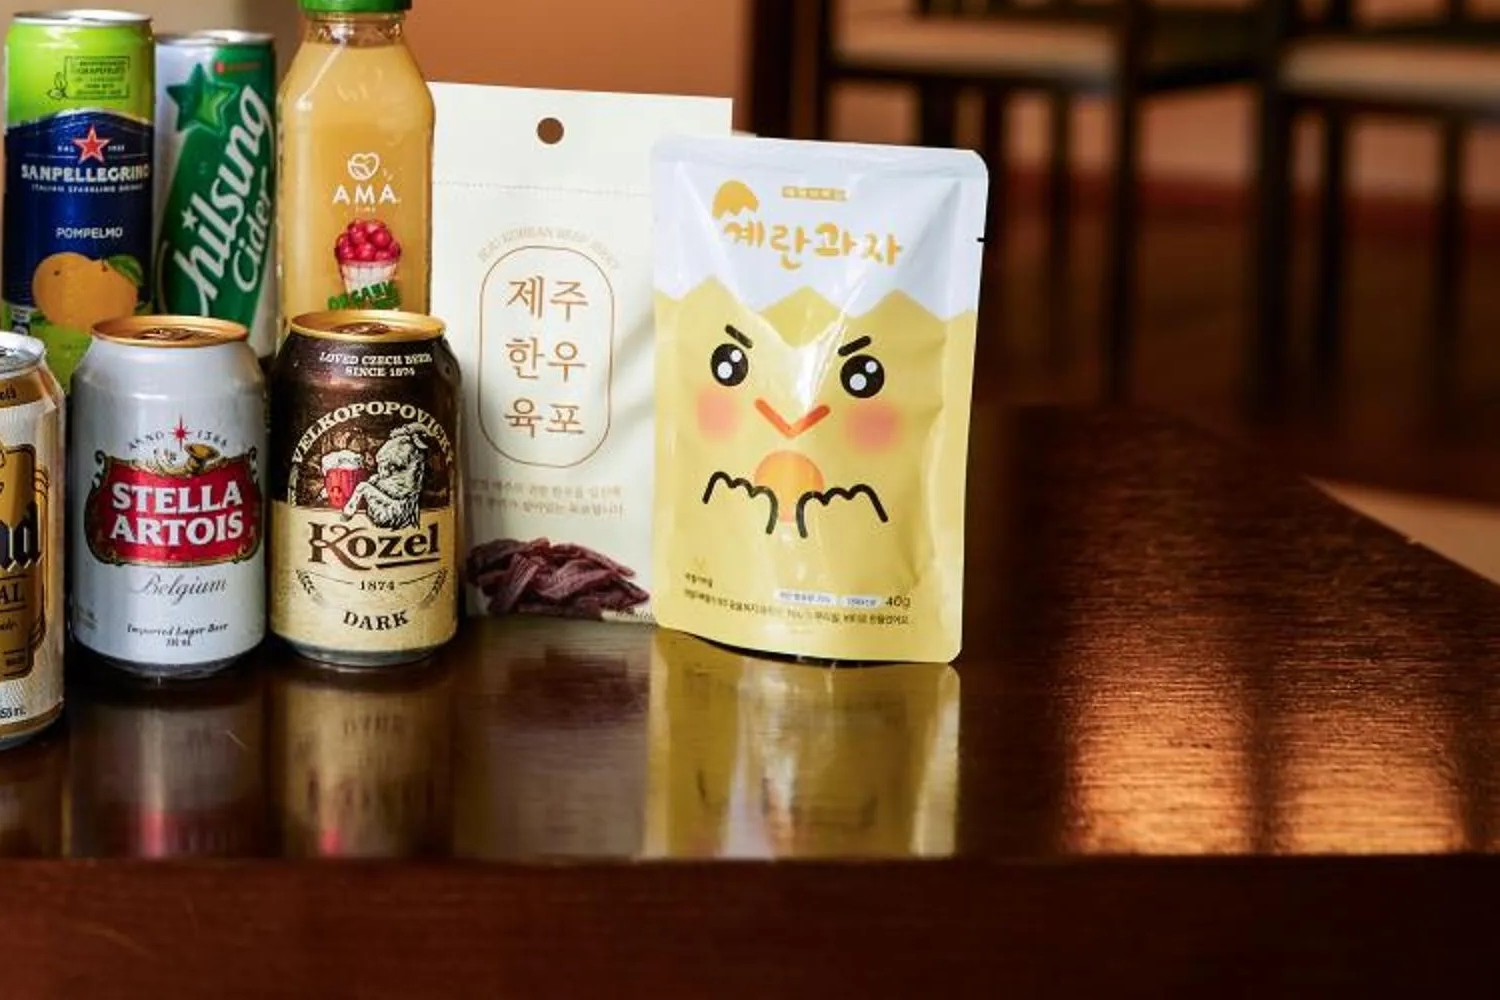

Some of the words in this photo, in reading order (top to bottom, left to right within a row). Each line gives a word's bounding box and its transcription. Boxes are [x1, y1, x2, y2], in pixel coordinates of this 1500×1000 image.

[20, 163, 149, 183] SANPELLEGRINO
[333, 184, 398, 205] AMA
[55, 226, 123, 239] POMPELMO
[232, 166, 272, 293] Cider
[722, 219, 904, 271] 계란과자
[506, 275, 589, 322] 제주
[319, 351, 359, 365] LOVED
[361, 353, 403, 366] CZECH
[404, 352, 433, 365] BEER
[345, 367, 387, 377] SINCE
[504, 337, 588, 382] 한우
[504, 398, 585, 438] 육포
[112, 480, 244, 514] STELLA
[110, 510, 244, 546] ARTOIS
[308, 521, 441, 571] Kozel
[130, 571, 228, 606] Belgium
[360, 579, 395, 592] 1874
[885, 594, 911, 610] 40g
[343, 609, 409, 631] DARK
